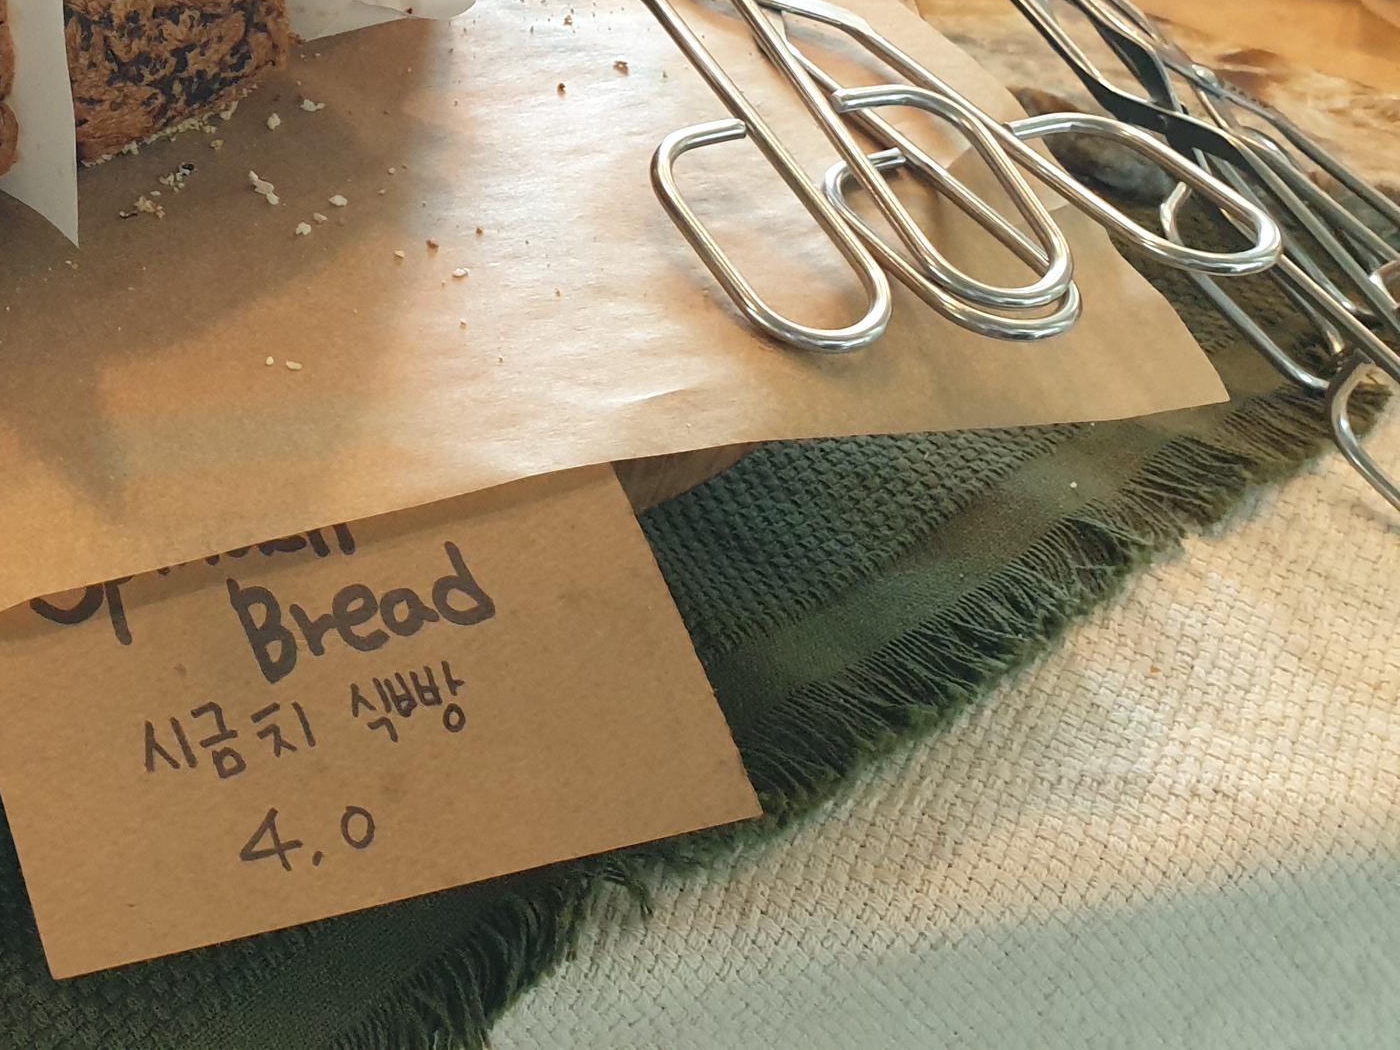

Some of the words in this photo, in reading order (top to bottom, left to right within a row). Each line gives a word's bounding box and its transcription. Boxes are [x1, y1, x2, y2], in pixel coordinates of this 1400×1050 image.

[227, 541, 496, 684] Bread
[143, 700, 316, 779] 시금치
[350, 660, 466, 743] 식빵
[239, 805, 376, 872] 4.0
